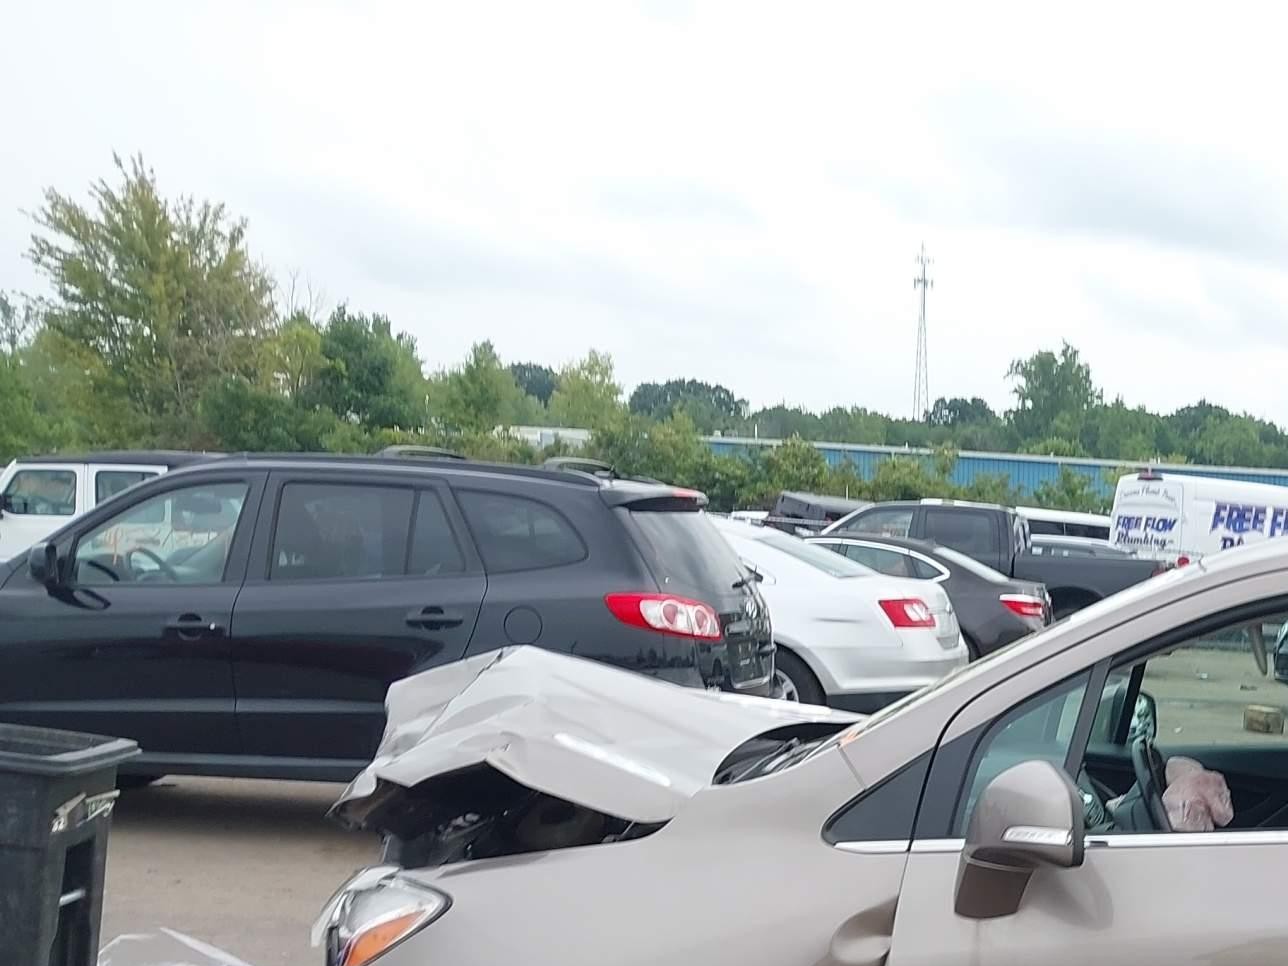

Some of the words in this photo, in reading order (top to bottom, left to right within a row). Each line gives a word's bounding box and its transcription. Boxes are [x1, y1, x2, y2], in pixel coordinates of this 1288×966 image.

[1115, 515, 1142, 531] FREE
[1143, 516, 1177, 532] FLOW
[1210, 503, 1266, 534] FREE
[1115, 531, 1167, 550] Plumbing
